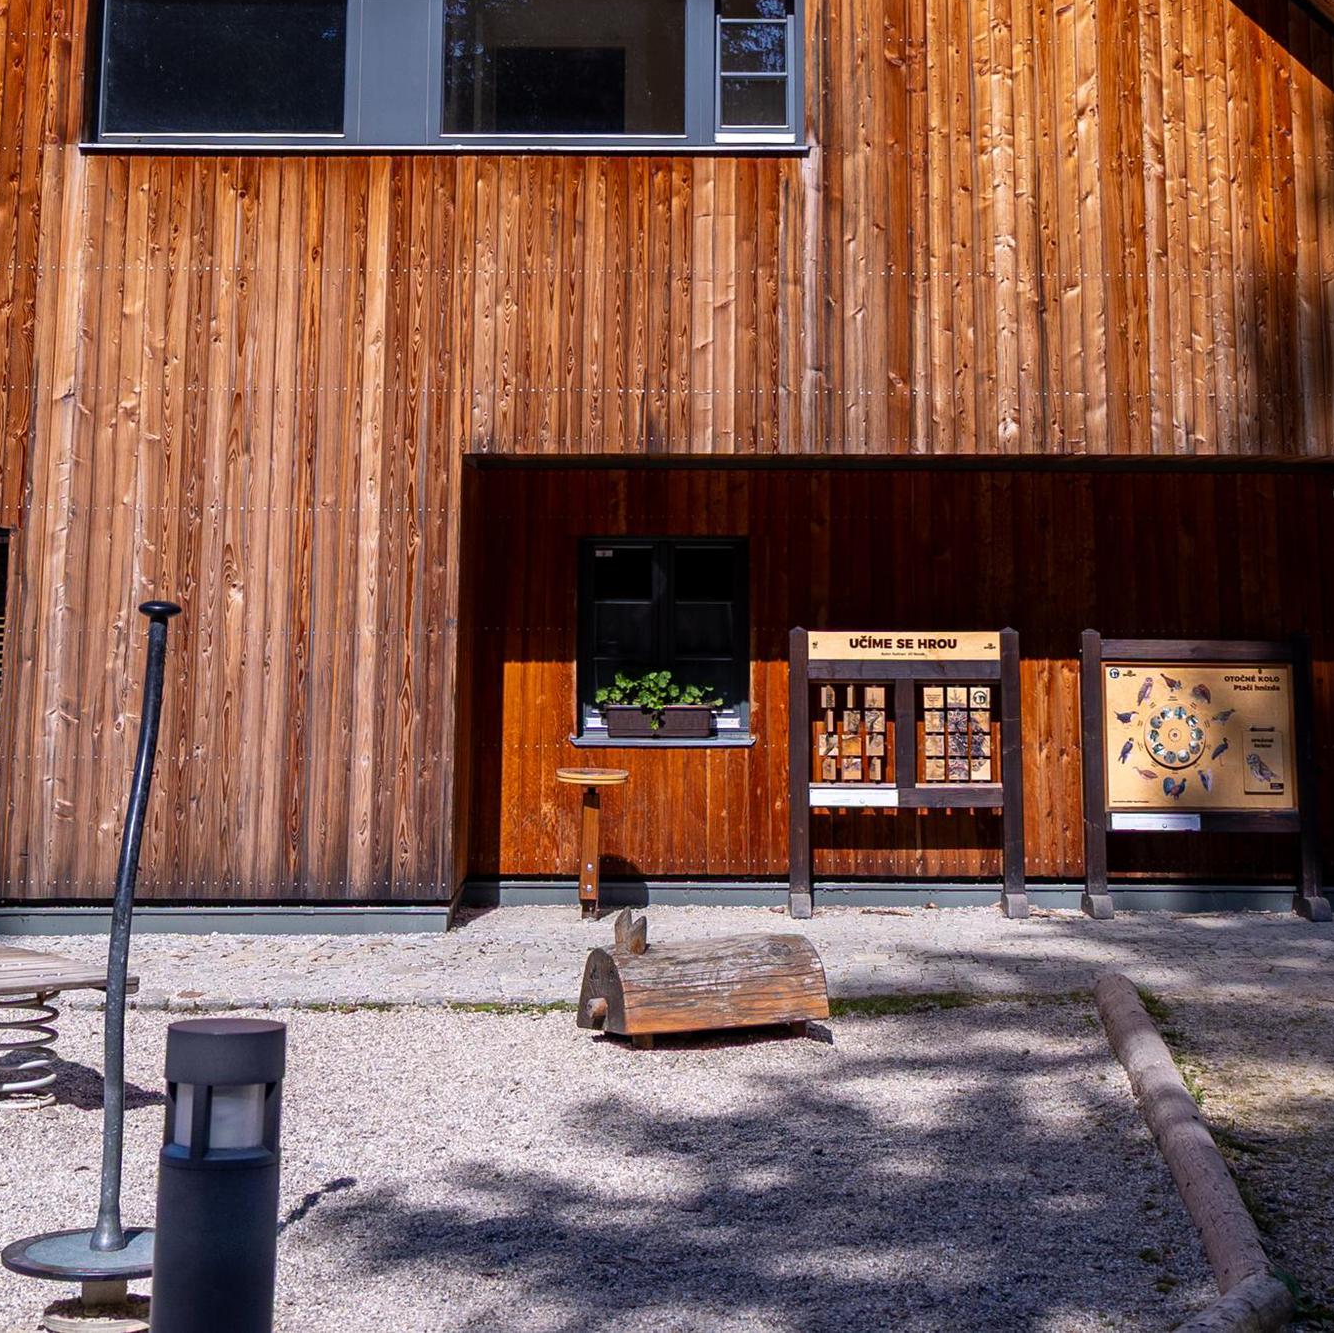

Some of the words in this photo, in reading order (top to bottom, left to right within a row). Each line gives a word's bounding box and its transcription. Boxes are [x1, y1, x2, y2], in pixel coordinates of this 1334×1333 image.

[849, 635, 893, 649] UČÍME
[896, 638, 914, 649] SE
[917, 638, 958, 649] HROU
[1224, 675, 1256, 683] OTOČNÉ
